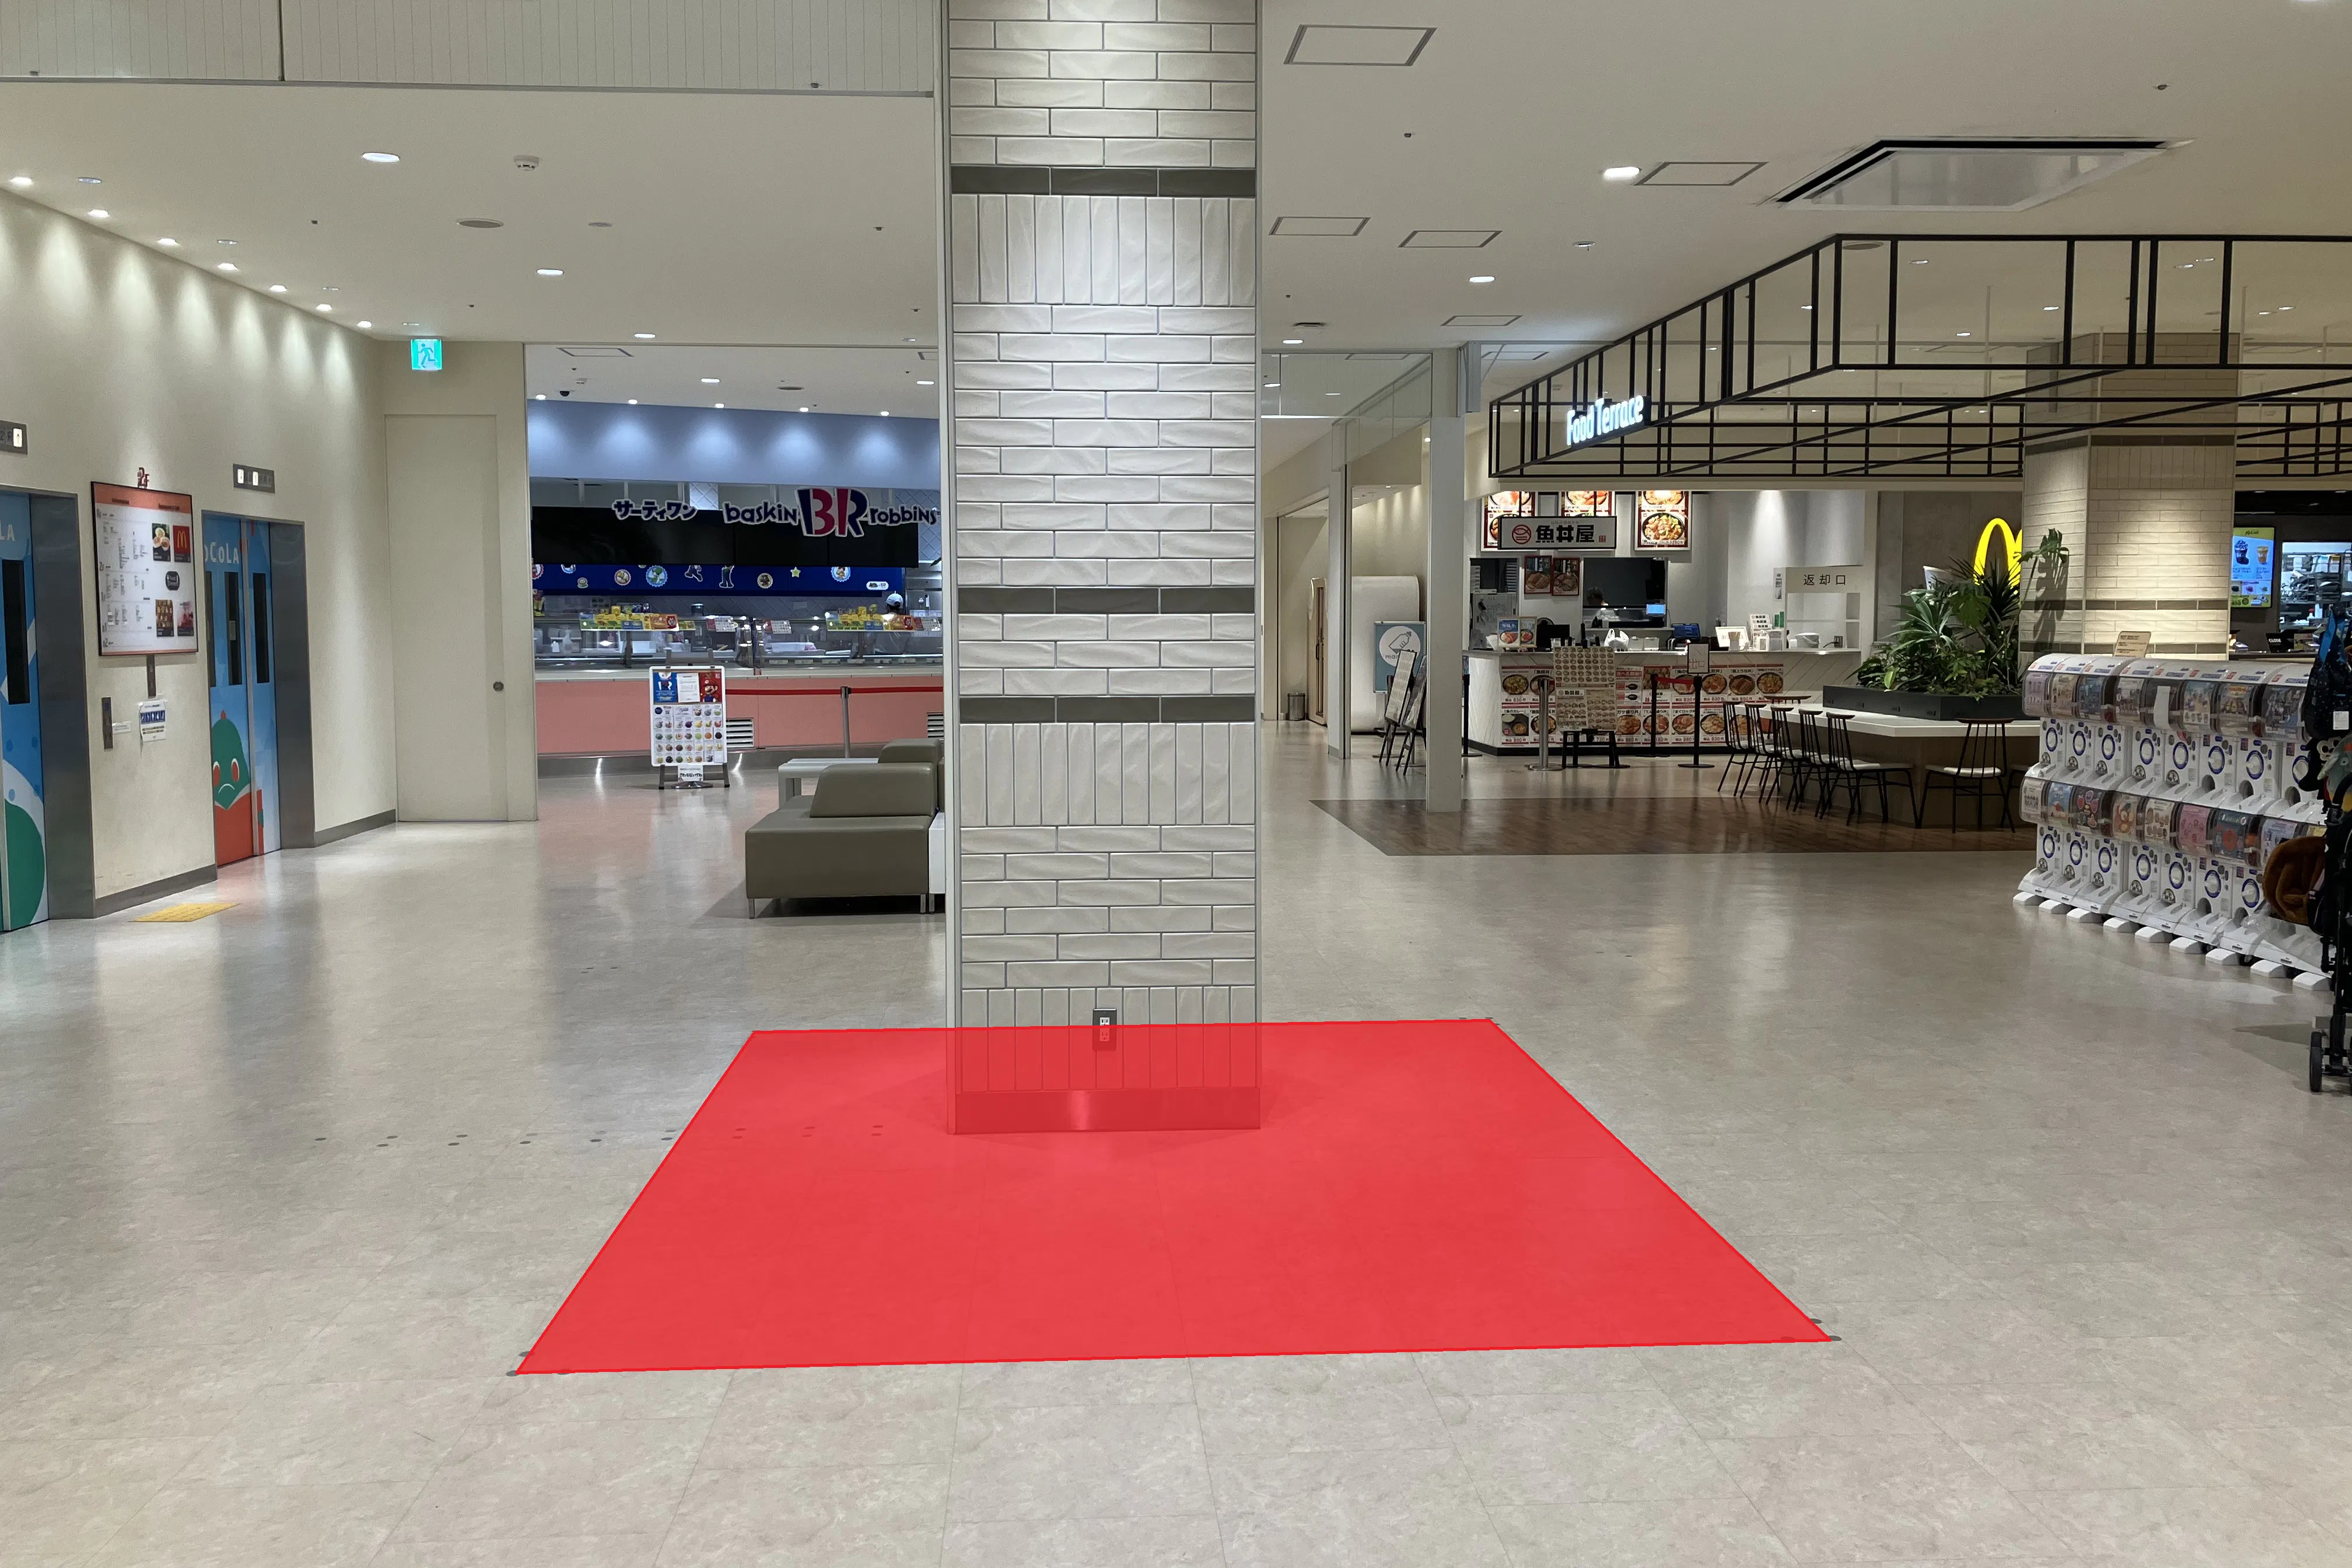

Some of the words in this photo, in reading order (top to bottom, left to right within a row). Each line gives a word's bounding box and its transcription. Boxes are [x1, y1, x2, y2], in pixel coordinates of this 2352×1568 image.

[1567, 405, 1594, 446] Food
[1595, 396, 1644, 436] Terrace
[613, 500, 696, 520] サーティワン
[1535, 525, 1595, 543] 魚丼屋
[1803, 574, 1846, 585] 返却口
[1689, 657, 1704, 670] 出口
